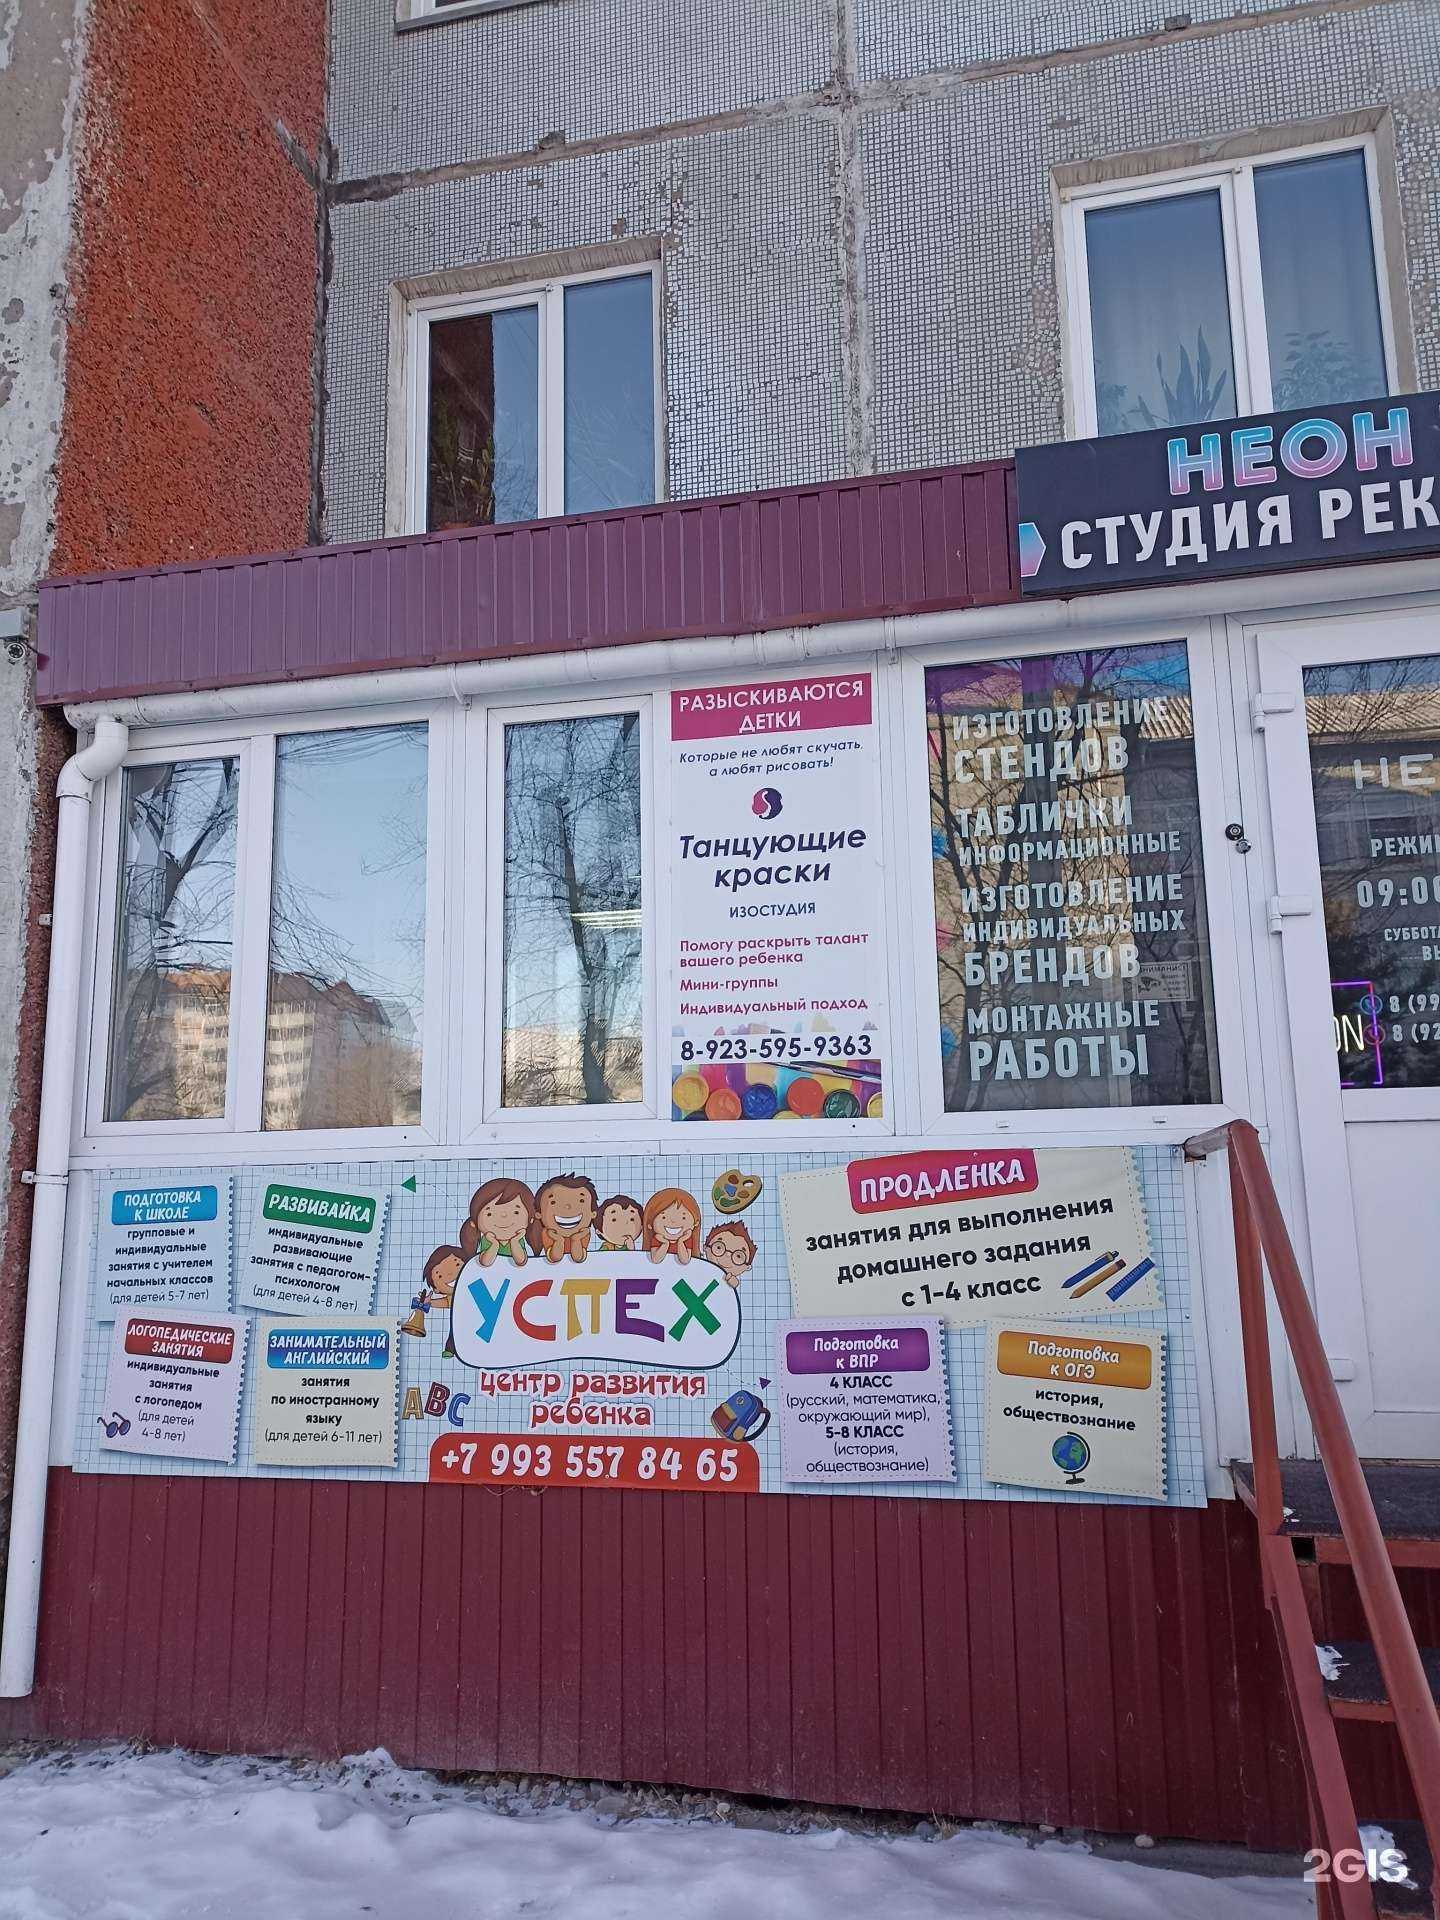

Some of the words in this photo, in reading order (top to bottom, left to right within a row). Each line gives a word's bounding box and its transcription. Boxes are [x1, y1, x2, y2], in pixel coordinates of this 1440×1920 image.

[1167, 407, 1414, 496] НЕОН
[1061, 494, 1293, 570] СТУДИЯ
[1318, 476, 1440, 539] РЕК
[679, 680, 864, 712] РАЗЫСКИВАЮТСЯ
[738, 711, 801, 734] ДЕТКИ
[953, 696, 1168, 740] ИЗГОТОВЛЕНИЕ
[680, 750, 737, 763] Которые
[741, 748, 757, 758] не
[761, 745, 802, 757] любят
[954, 736, 1129, 784] СТЕНДОВ
[709, 768, 717, 776] а
[721, 763, 762, 776] любят
[766, 757, 834, 774] рисовать!
[955, 795, 1133, 838] ТАБЛИЧКИ
[680, 828, 867, 860] Танцующие
[958, 831, 1181, 866] ИНФОРМАЦИОННЫЕ
[714, 862, 831, 892] краски
[961, 873, 1184, 914] ИЗГОТОВЛЕНИЕ
[729, 902, 816, 918] ИЗОСТУДИЯ
[963, 909, 1186, 945] ИНДИВИДУАЛЬНЫХ
[1384, 925, 1440, 941] СУББОТ
[680, 940, 733, 952] Помогу
[738, 936, 811, 951] раскрыть
[816, 933, 869, 946] талант
[680, 956, 734, 967] вашего
[739, 952, 803, 967] ребенка
[964, 944, 1141, 988] БРЕНДОВ
[680, 977, 778, 991] Мини-группы
[680, 998, 806, 1015] Индивидуальный
[811, 998, 868, 1010] подход
[1390, 995, 1400, 1013] 8
[967, 1000, 1160, 1034] МОНТАЖНЫЕ
[1392, 1024, 1403, 1042] 8
[680, 1034, 872, 1061] 8-923-595-9363
[969, 1034, 1149, 1081] РАБОТЫ
[860, 1158, 1025, 1204] ПРОДЛЕНКА
[124, 1190, 201, 1207] ПОДГОТОВКА
[145, 1207, 189, 1221] ШКОЛЕ
[268, 1193, 370, 1223] РАЗВИВАЙКА
[805, 1225, 901, 1251] занятия
[908, 1219, 951, 1243] для
[958, 1197, 1114, 1232] выполнения
[127, 1227, 185, 1240] групповые
[268, 1227, 364, 1248] индивидуальные
[115, 1243, 207, 1255] индивидуальные
[272, 1242, 353, 1263] развивающие
[108, 1262, 150, 1272] занятия
[162, 1260, 213, 1271] учителем
[250, 1255, 294, 1270] занятия
[306, 1263, 371, 1281] педагогом-
[837, 1246, 977, 1284] домашнего
[984, 1235, 1091, 1264] задания
[107, 1278, 166, 1288] начальных
[169, 1275, 213, 1285] классов
[275, 1274, 340, 1293] психологом
[901, 1291, 915, 1307] с
[920, 1284, 961, 1305] 1-4
[968, 1274, 1042, 1300] класс
[109, 1293, 132, 1304] (для
[134, 1292, 165, 1303] детей
[168, 1290, 185, 1301] 5-7
[188, 1289, 209, 1300] лет)
[253, 1284, 276, 1298] (для
[277, 1289, 310, 1302] детей
[313, 1295, 333, 1307] 4-8
[335, 1300, 358, 1312] лет)
[467, 1278, 722, 1343] УСПЕХ
[128, 1324, 233, 1346] ЛОГОПЕДИЧЕСКИЕ
[270, 1333, 387, 1349] ЗАНИМАТЕЛЬНЫЙ
[814, 1334, 899, 1352] Подготовка
[151, 1341, 204, 1358] ЗАНЯТИЯ
[284, 1349, 370, 1365] АНГЛИЙСКИЙ
[1028, 1340, 1120, 1363] Подготовка
[127, 1360, 220, 1378] индивидуальные
[836, 1358, 844, 1369] к
[849, 1353, 879, 1368] ВПР
[1050, 1364, 1059, 1376] к
[1064, 1363, 1095, 1378] ОГЭ
[149, 1379, 192, 1392] занятия
[301, 1377, 350, 1387] занятия
[481, 1371, 561, 1397] центр
[571, 1373, 706, 1397] развития
[830, 1376, 839, 1388] 4
[843, 1375, 893, 1388] КЛАСС
[135, 1395, 141, 1403] с
[144, 1395, 202, 1410] логопедом
[271, 1395, 286, 1405] по
[289, 1395, 379, 1408] иностранному
[786, 1393, 849, 1408] (русский,
[853, 1393, 940, 1405] математика,
[1035, 1389, 1104, 1408] история,
[138, 1410, 160, 1423] (для
[162, 1413, 195, 1426] детей
[305, 1414, 342, 1426] языку
[531, 1398, 652, 1428] ребенка
[798, 1409, 890, 1424] окружающий
[895, 1406, 930, 1421] мир),
[1003, 1405, 1136, 1431] обществознание
[142, 1427, 161, 1439] 4-8
[163, 1430, 186, 1442] лет)
[264, 1428, 289, 1442] (для
[292, 1430, 328, 1443] детей
[331, 1430, 354, 1442] 6-11
[357, 1431, 382, 1444] лет)
[825, 1426, 849, 1439] 5-8
[854, 1425, 904, 1438] КЛАСС
[834, 1442, 898, 1457] (история,
[441, 1443, 478, 1475] +7
[490, 1443, 552, 1477] 993
[565, 1445, 625, 1479] 557
[638, 1446, 682, 1481] 84
[696, 1448, 738, 1483] 65
[806, 1457, 929, 1473] обществознание)
